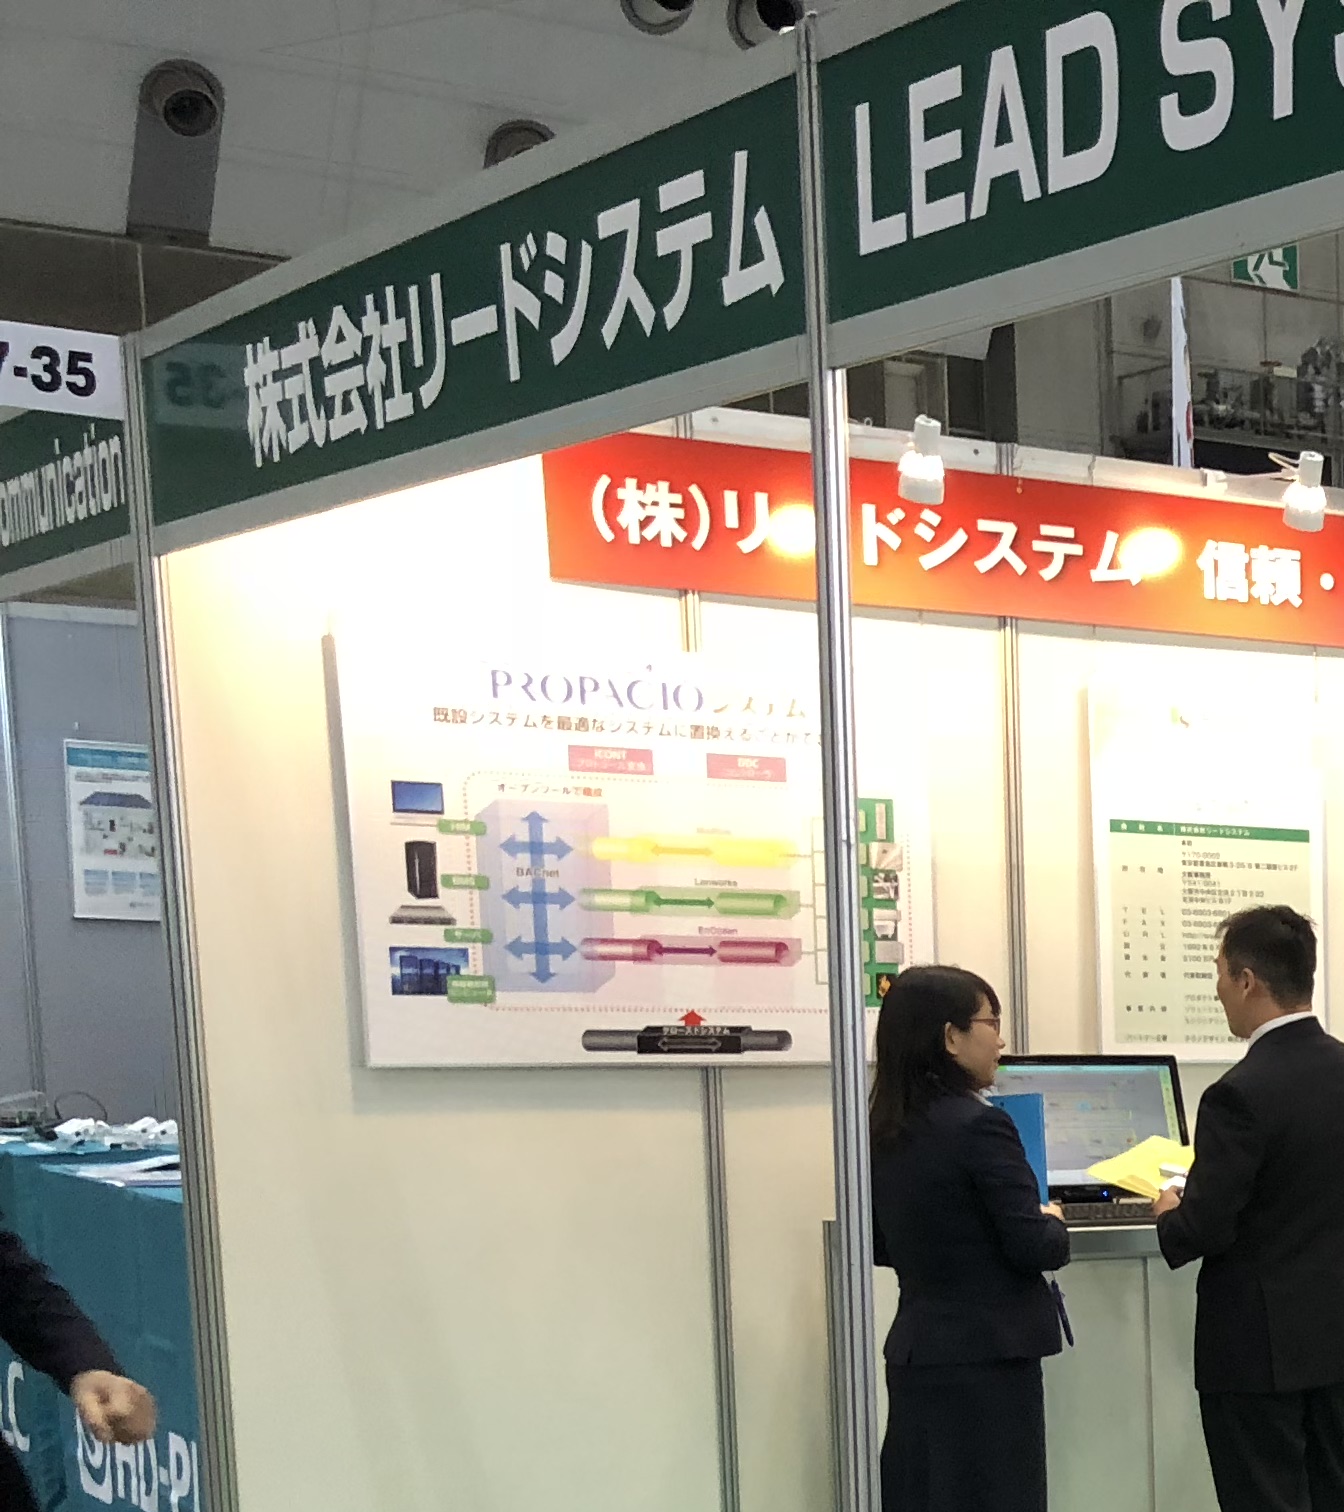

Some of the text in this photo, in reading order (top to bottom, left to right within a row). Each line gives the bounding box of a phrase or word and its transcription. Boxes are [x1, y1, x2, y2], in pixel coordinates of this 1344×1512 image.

[854, 10, 1121, 257] LEAD
[243, 149, 785, 469] 株式会社リードシステム
[590, 473, 1143, 587] （株）リドシステム
[490, 664, 705, 714] PROPACIO
